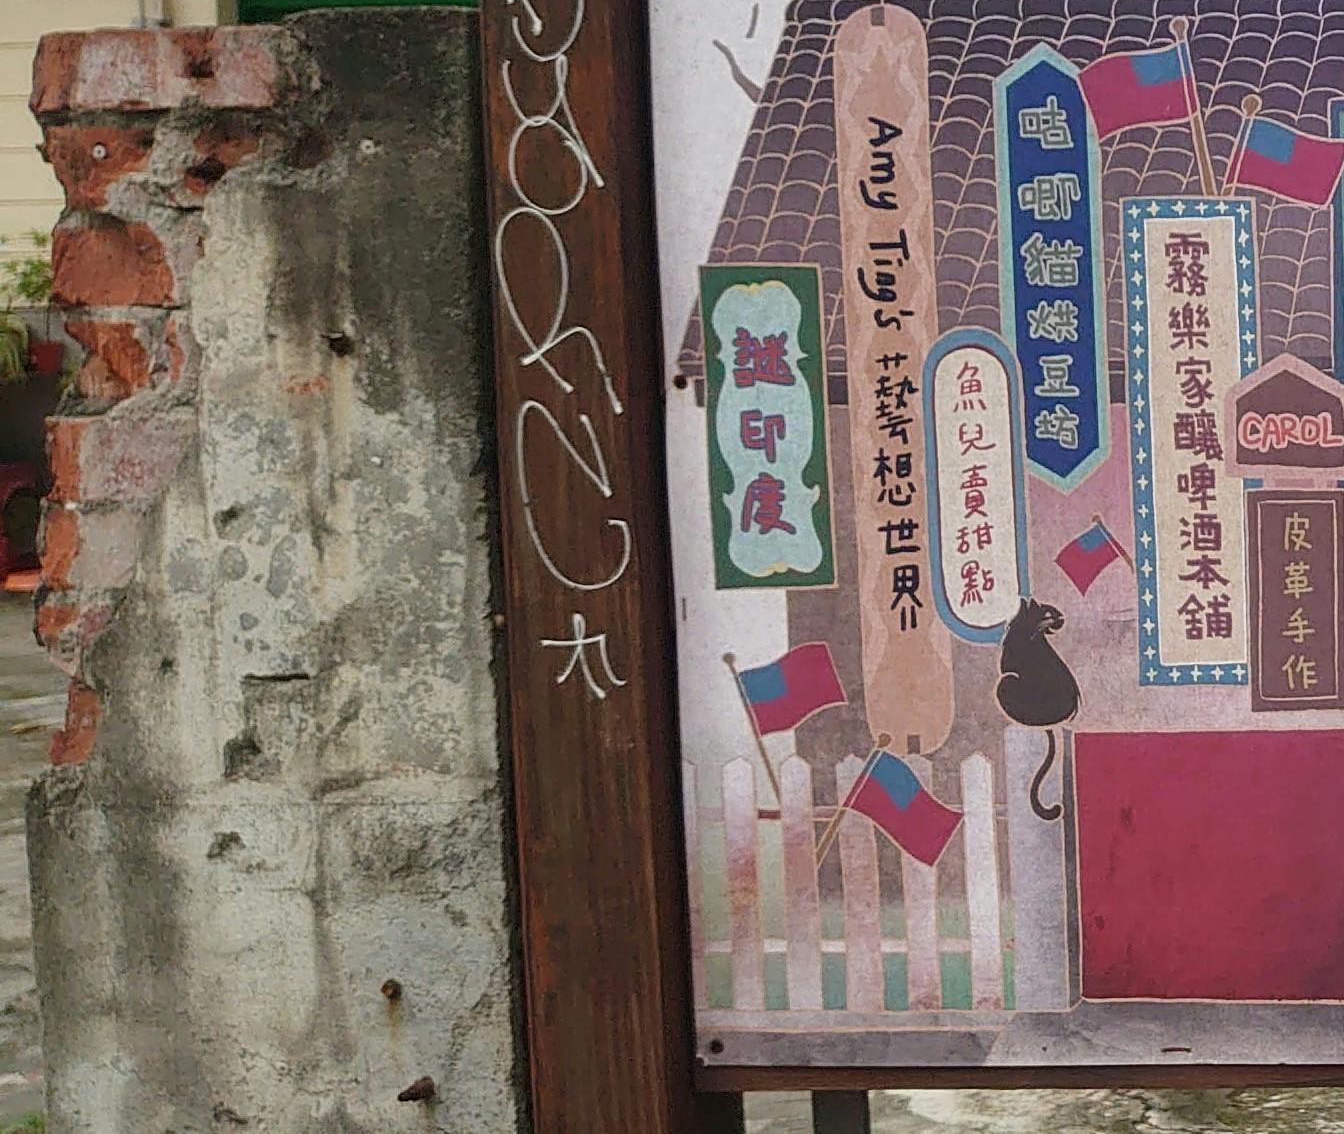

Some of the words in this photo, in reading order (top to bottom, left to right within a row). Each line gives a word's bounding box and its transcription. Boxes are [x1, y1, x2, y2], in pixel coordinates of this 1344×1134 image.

[859, 116, 903, 210] Amy
[732, 326, 798, 535] 謎印度
[872, 351, 924, 631] 藝想世界
[953, 360, 997, 608] 魚兒賣甜點
[1281, 511, 1320, 694] 皮革手作
